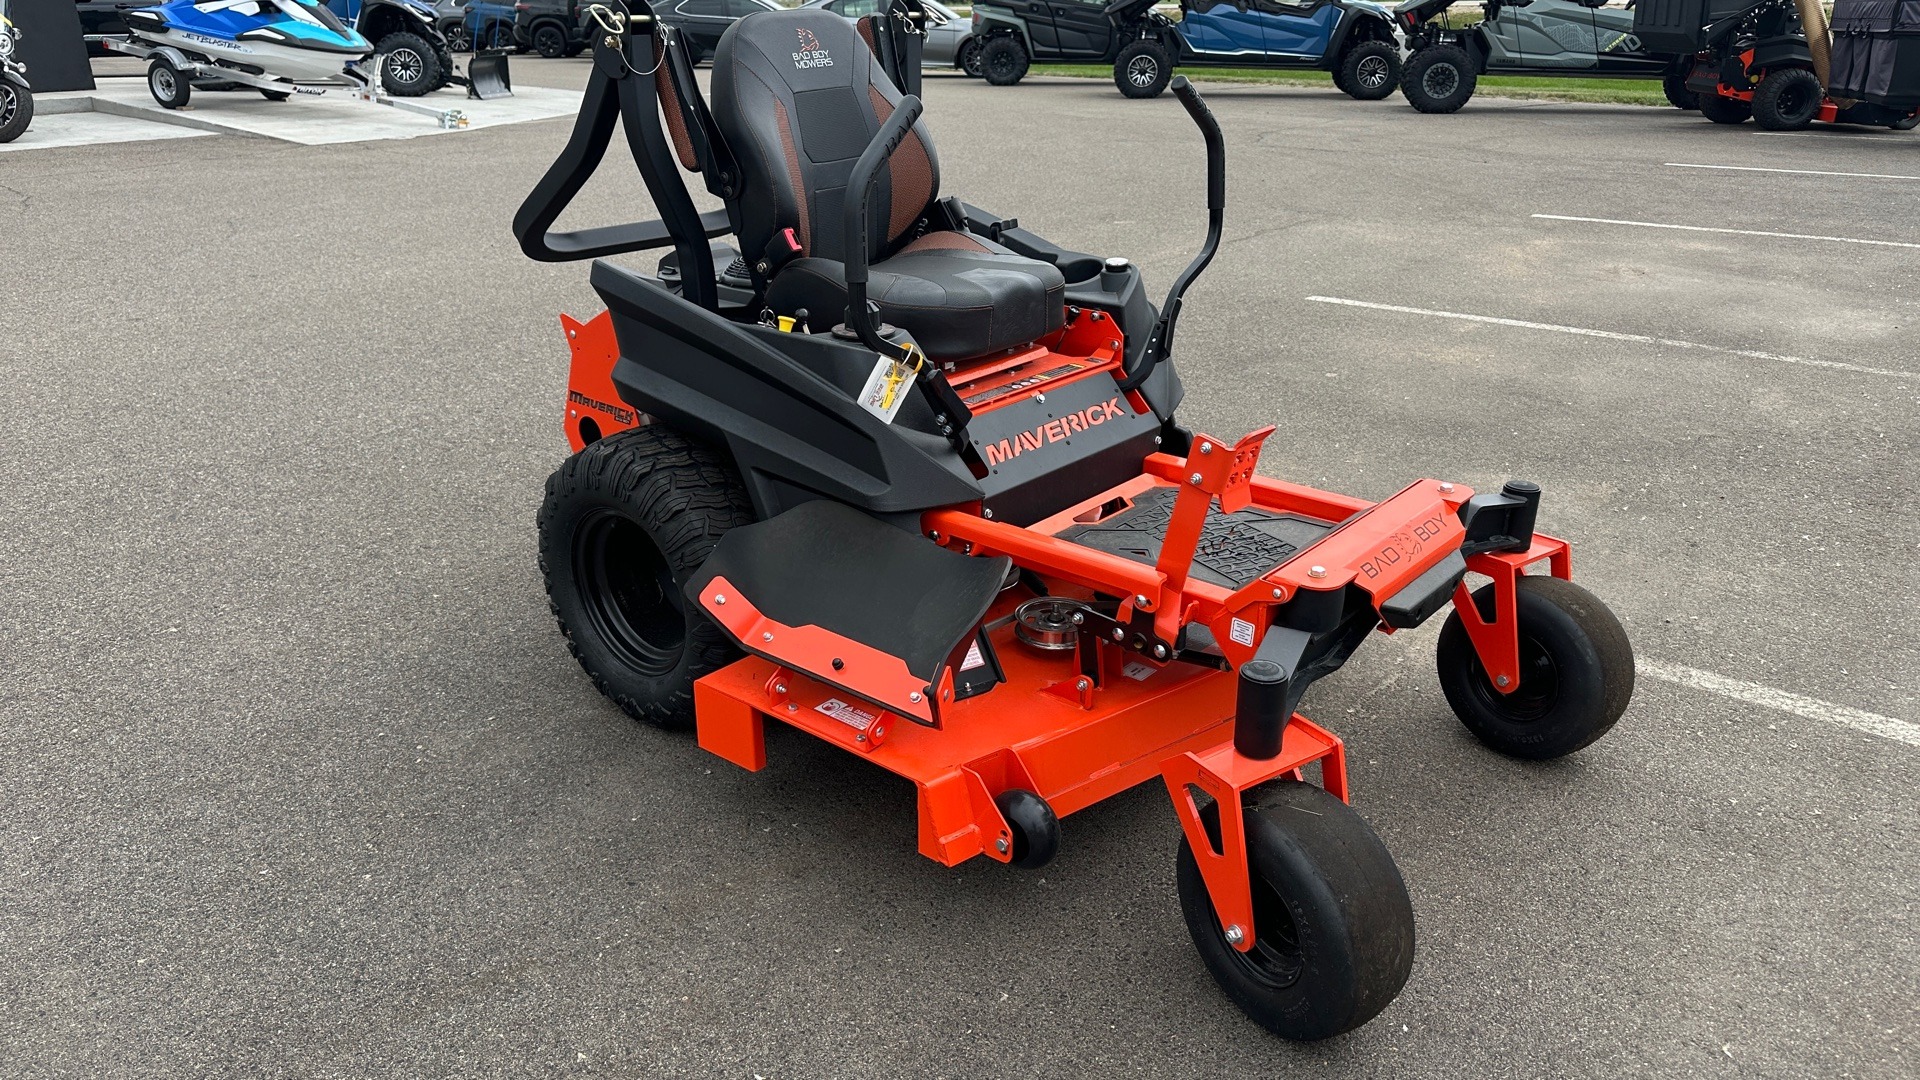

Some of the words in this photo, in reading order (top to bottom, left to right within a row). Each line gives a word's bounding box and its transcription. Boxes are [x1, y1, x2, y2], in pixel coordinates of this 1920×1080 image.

[182, 32, 242, 52] JETBLASTER
[791, 51, 811, 61] BAD
[811, 49, 829, 59] BOY
[794, 57, 834, 70] MOWERS
[568, 389, 635, 421] MAVERICK
[985, 396, 1126, 467] MAVERICK
[1360, 546, 1401, 579] BAD
[1413, 512, 1448, 542] BOY
